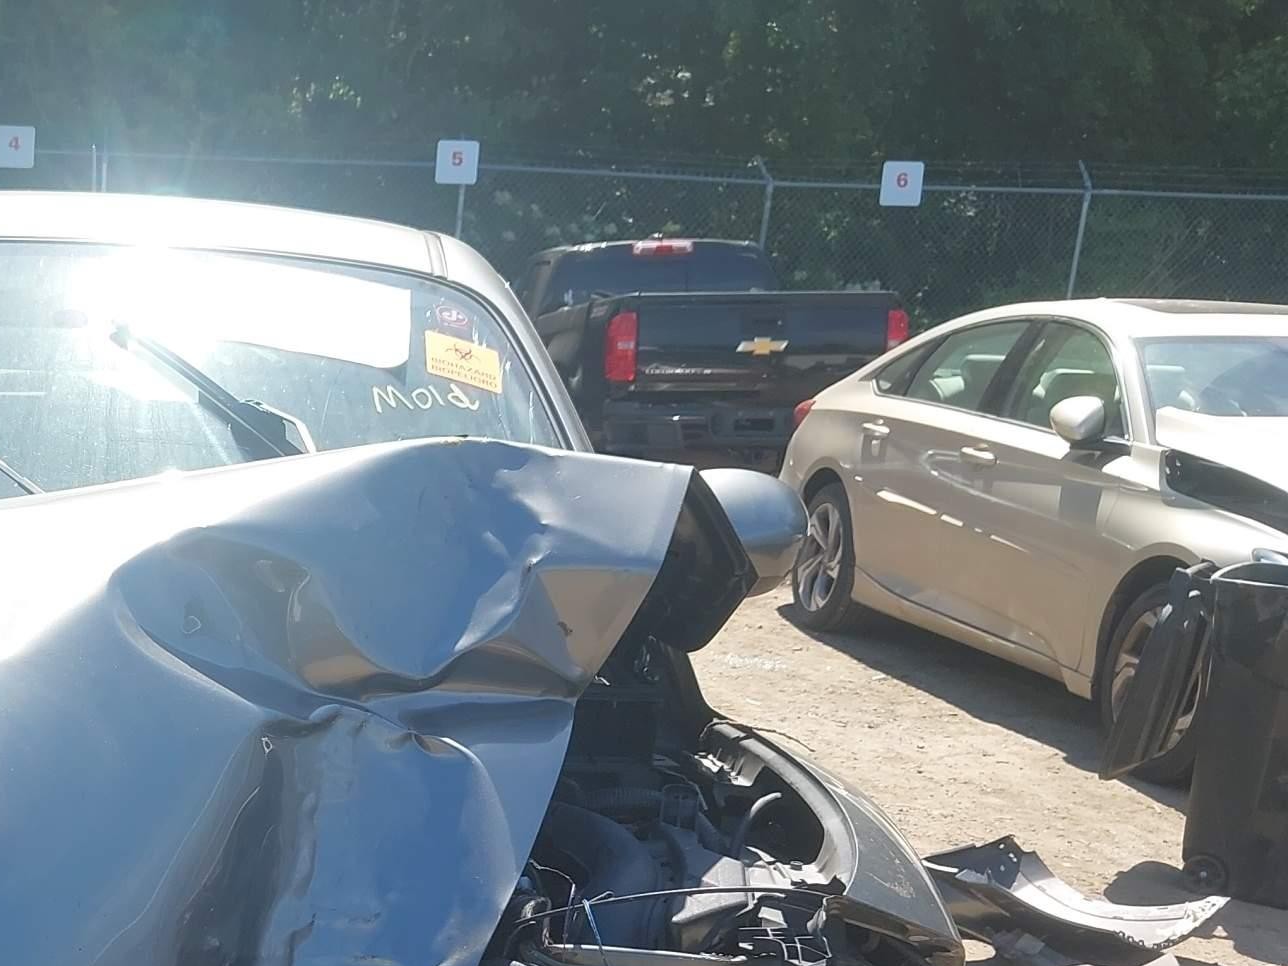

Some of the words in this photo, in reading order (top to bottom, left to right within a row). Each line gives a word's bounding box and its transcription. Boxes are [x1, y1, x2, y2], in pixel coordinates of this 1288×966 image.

[8, 136, 20, 151] 4
[451, 151, 464, 166] 5
[896, 172, 909, 188] 6
